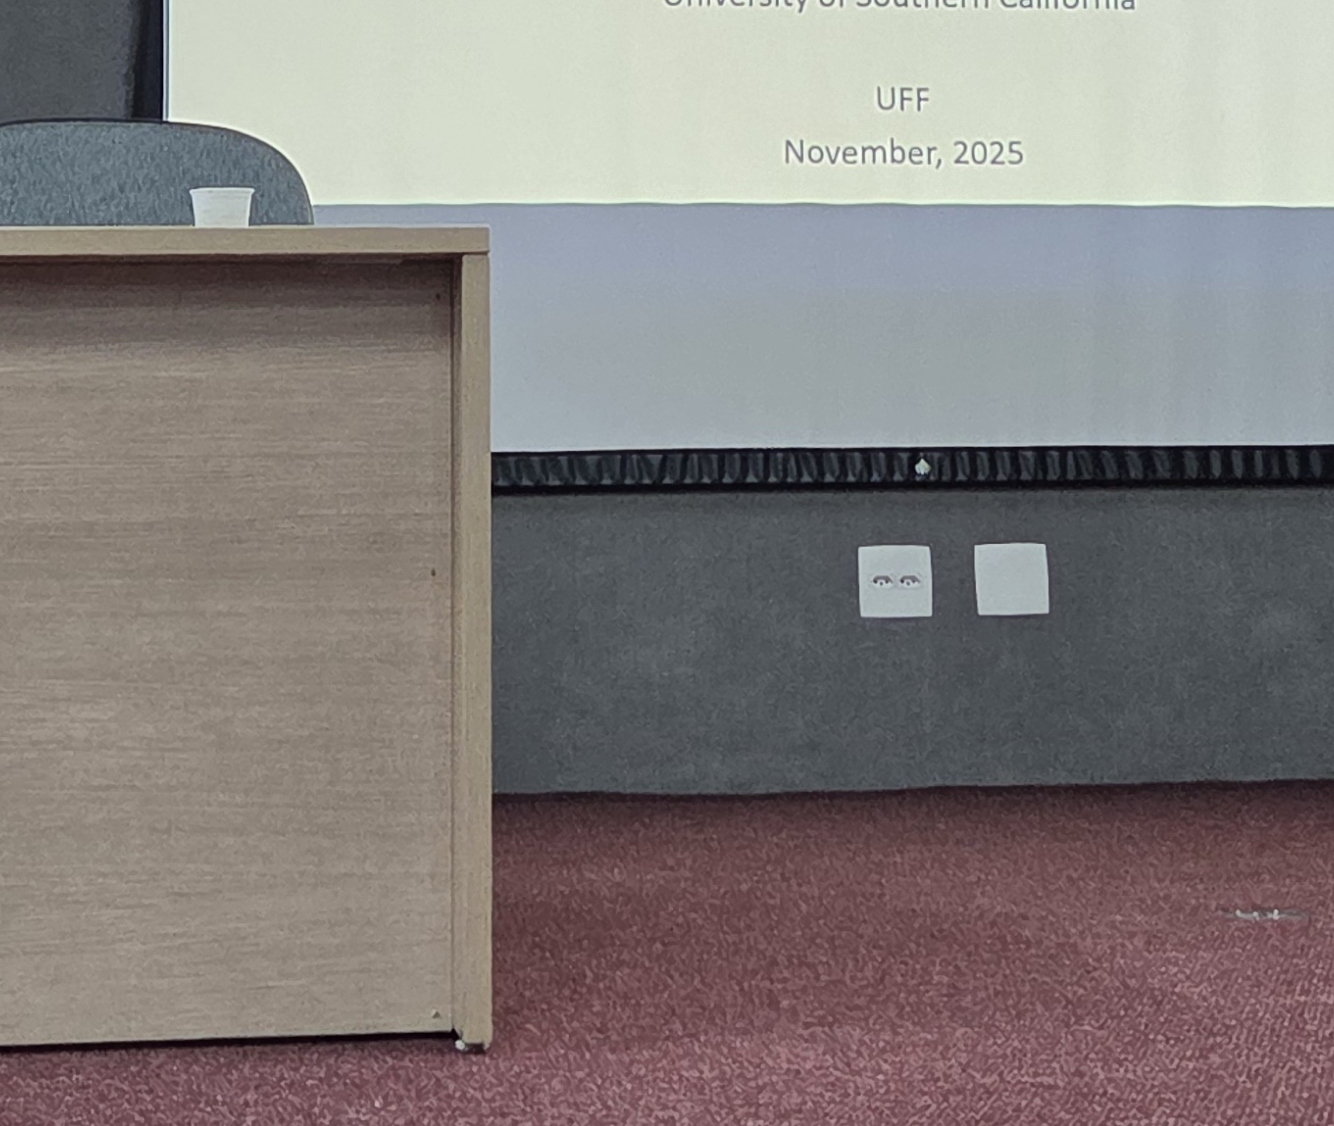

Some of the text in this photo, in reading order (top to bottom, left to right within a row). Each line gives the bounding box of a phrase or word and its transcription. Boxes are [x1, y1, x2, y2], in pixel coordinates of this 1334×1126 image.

[876, 86, 929, 112] UFF
[784, 139, 1023, 169] November, 2025
